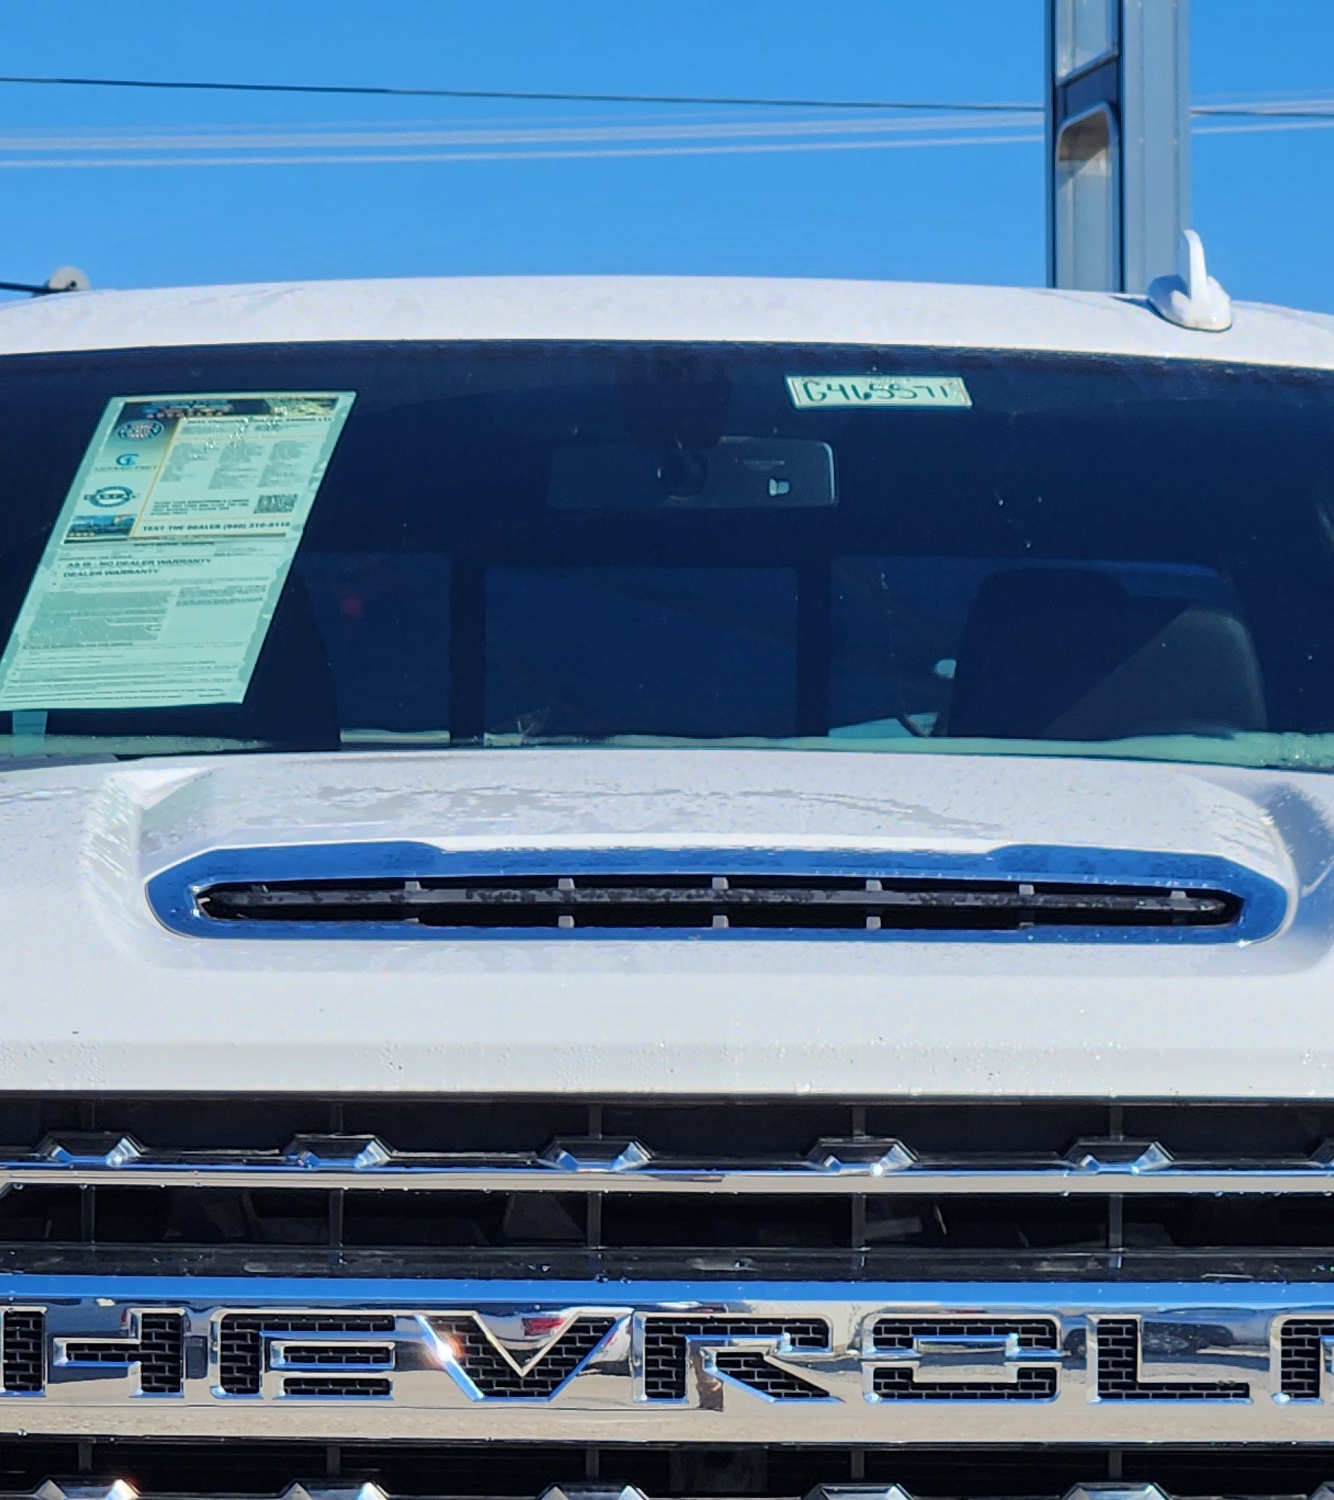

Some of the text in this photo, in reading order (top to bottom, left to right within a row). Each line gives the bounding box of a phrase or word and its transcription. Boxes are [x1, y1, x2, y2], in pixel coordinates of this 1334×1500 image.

[187, 523, 221, 531] DEALER
[116, 559, 156, 567] DEALER
[157, 558, 212, 566] WARRANTY
[63, 568, 159, 578] DEALER WARRANTY
